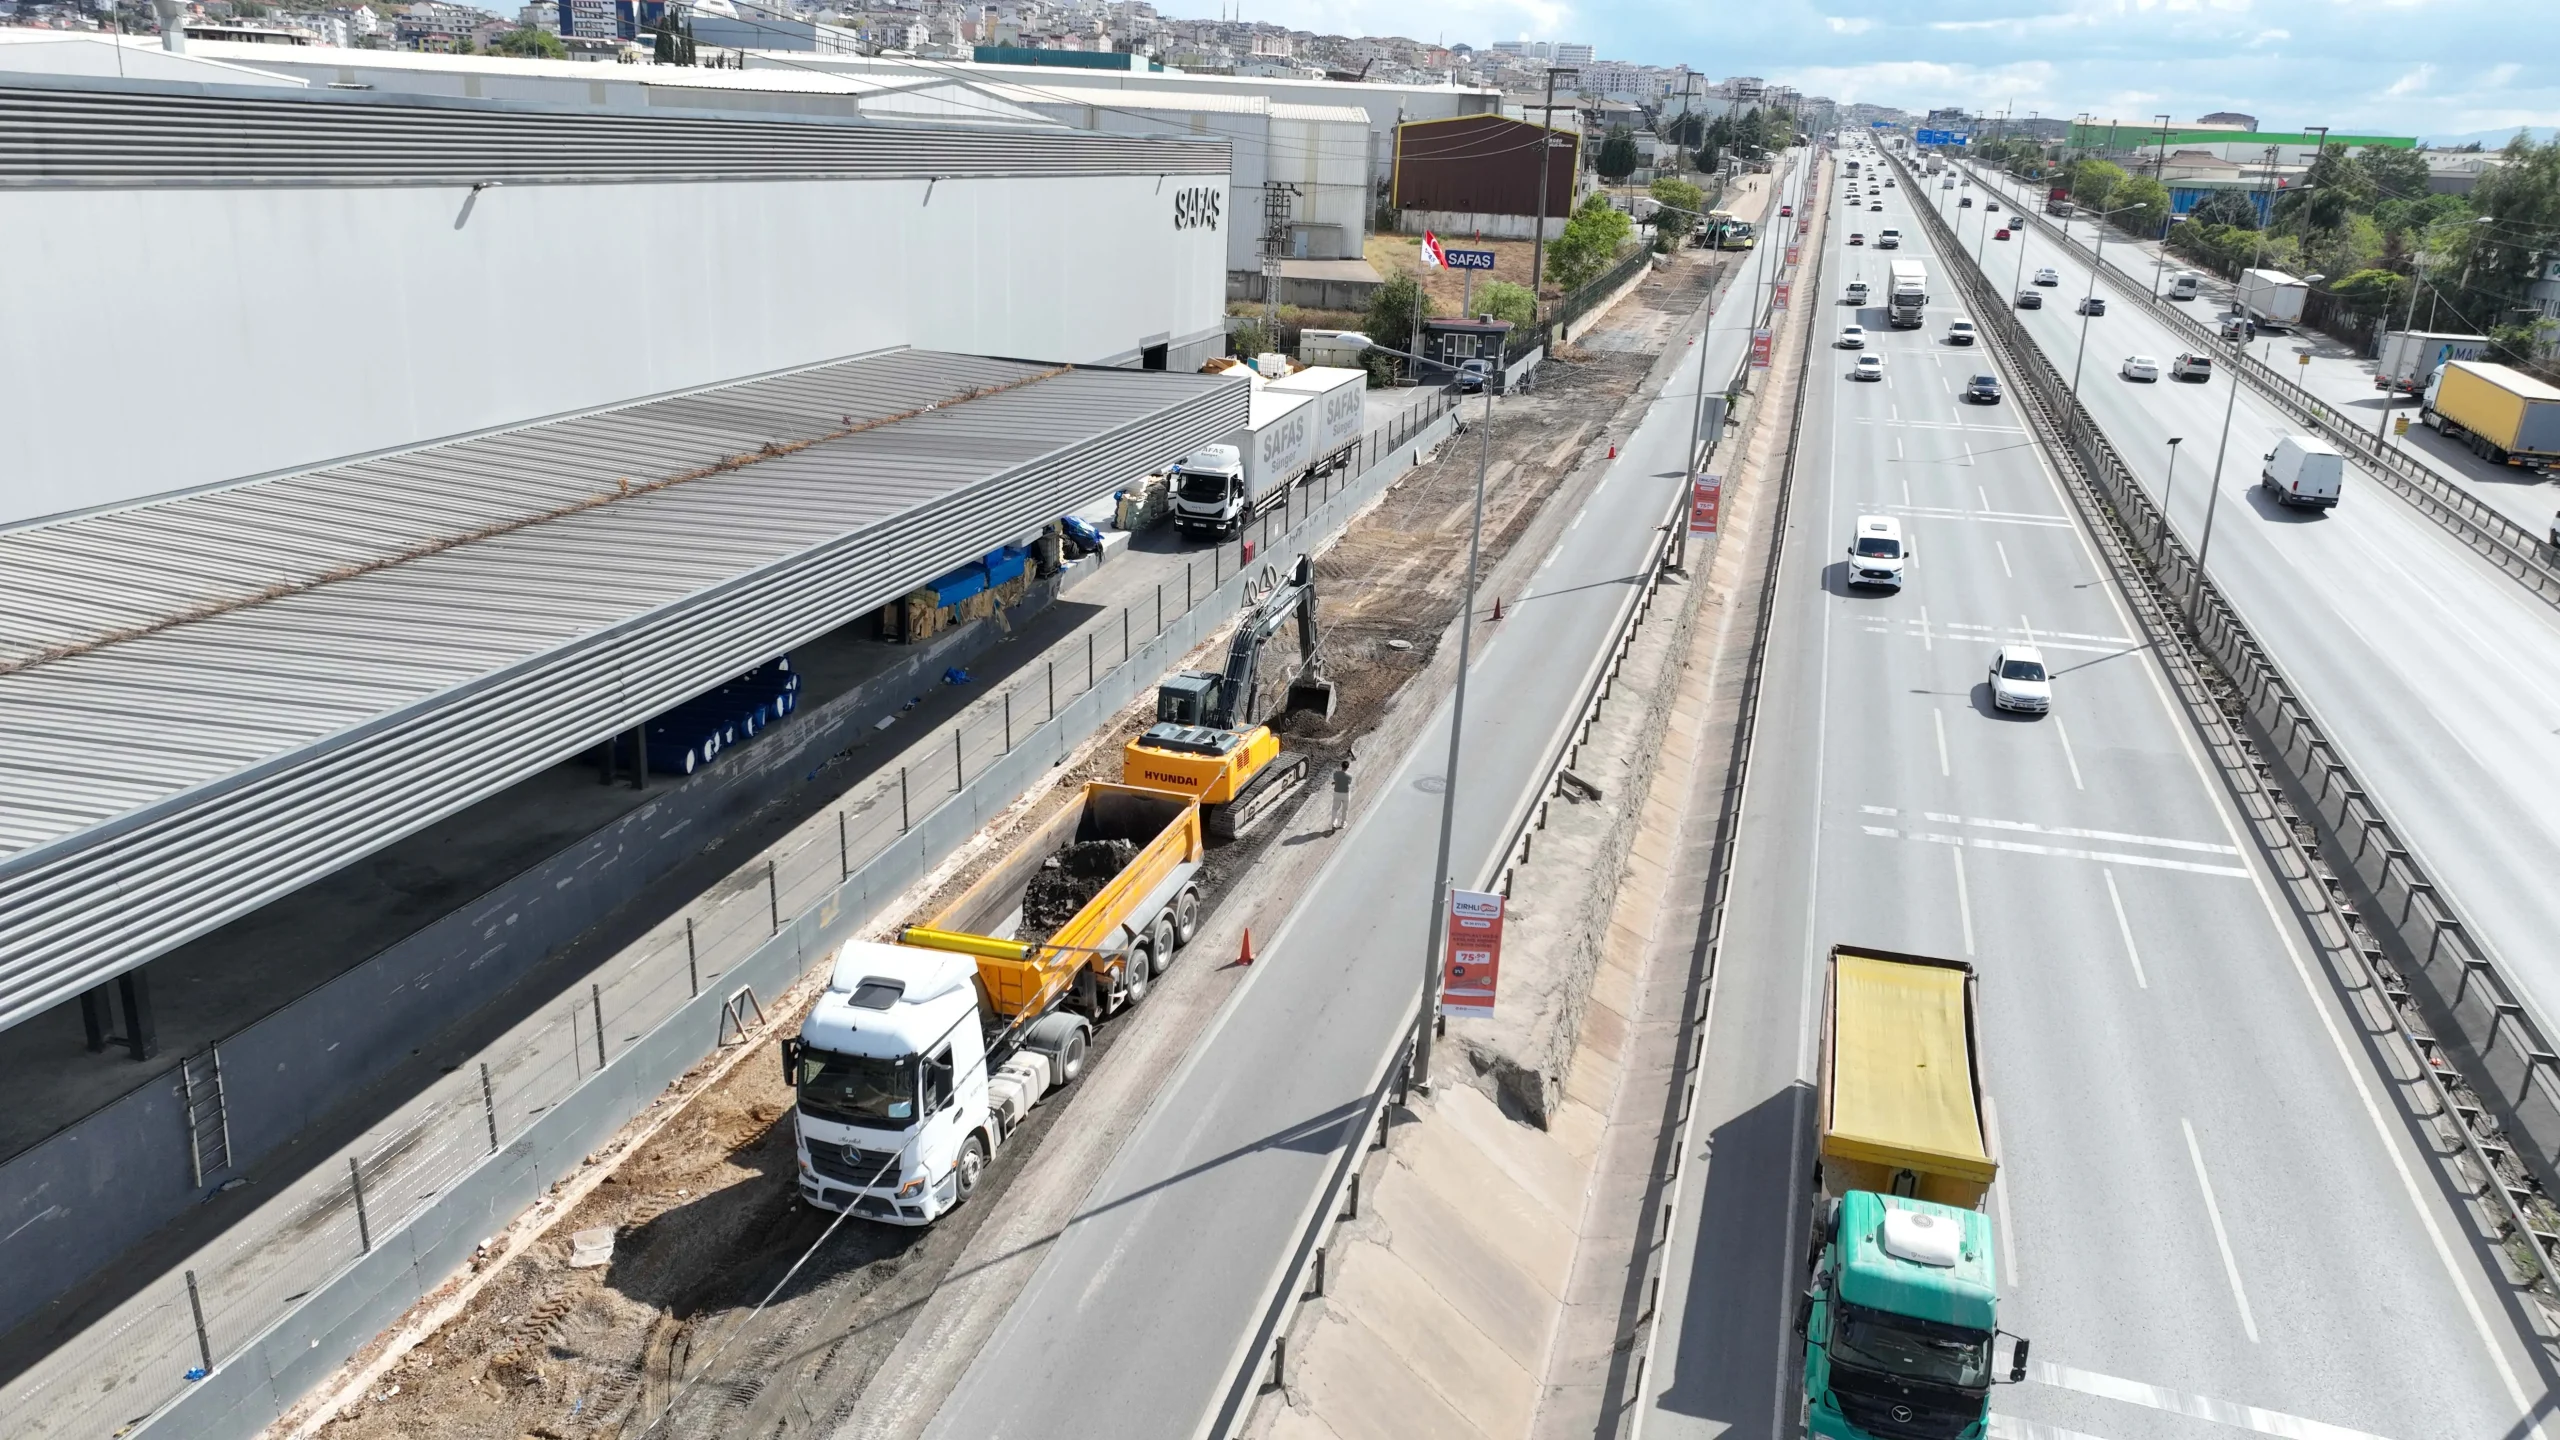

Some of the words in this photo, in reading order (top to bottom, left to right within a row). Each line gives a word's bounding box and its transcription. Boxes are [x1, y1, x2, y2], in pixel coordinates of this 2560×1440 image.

[1175, 187, 1220, 231] SAFAŞ
[1448, 253, 1491, 268] SAFAŞ
[1327, 386, 1360, 425] SAFAŞ
[1332, 418, 1353, 437] Sünger
[1264, 415, 1304, 463] SAFAŞ
[1271, 450, 1297, 474] Sünger
[1145, 770, 1198, 786] HYUNDAI
[1456, 902, 1480, 911] ZIRHLI
